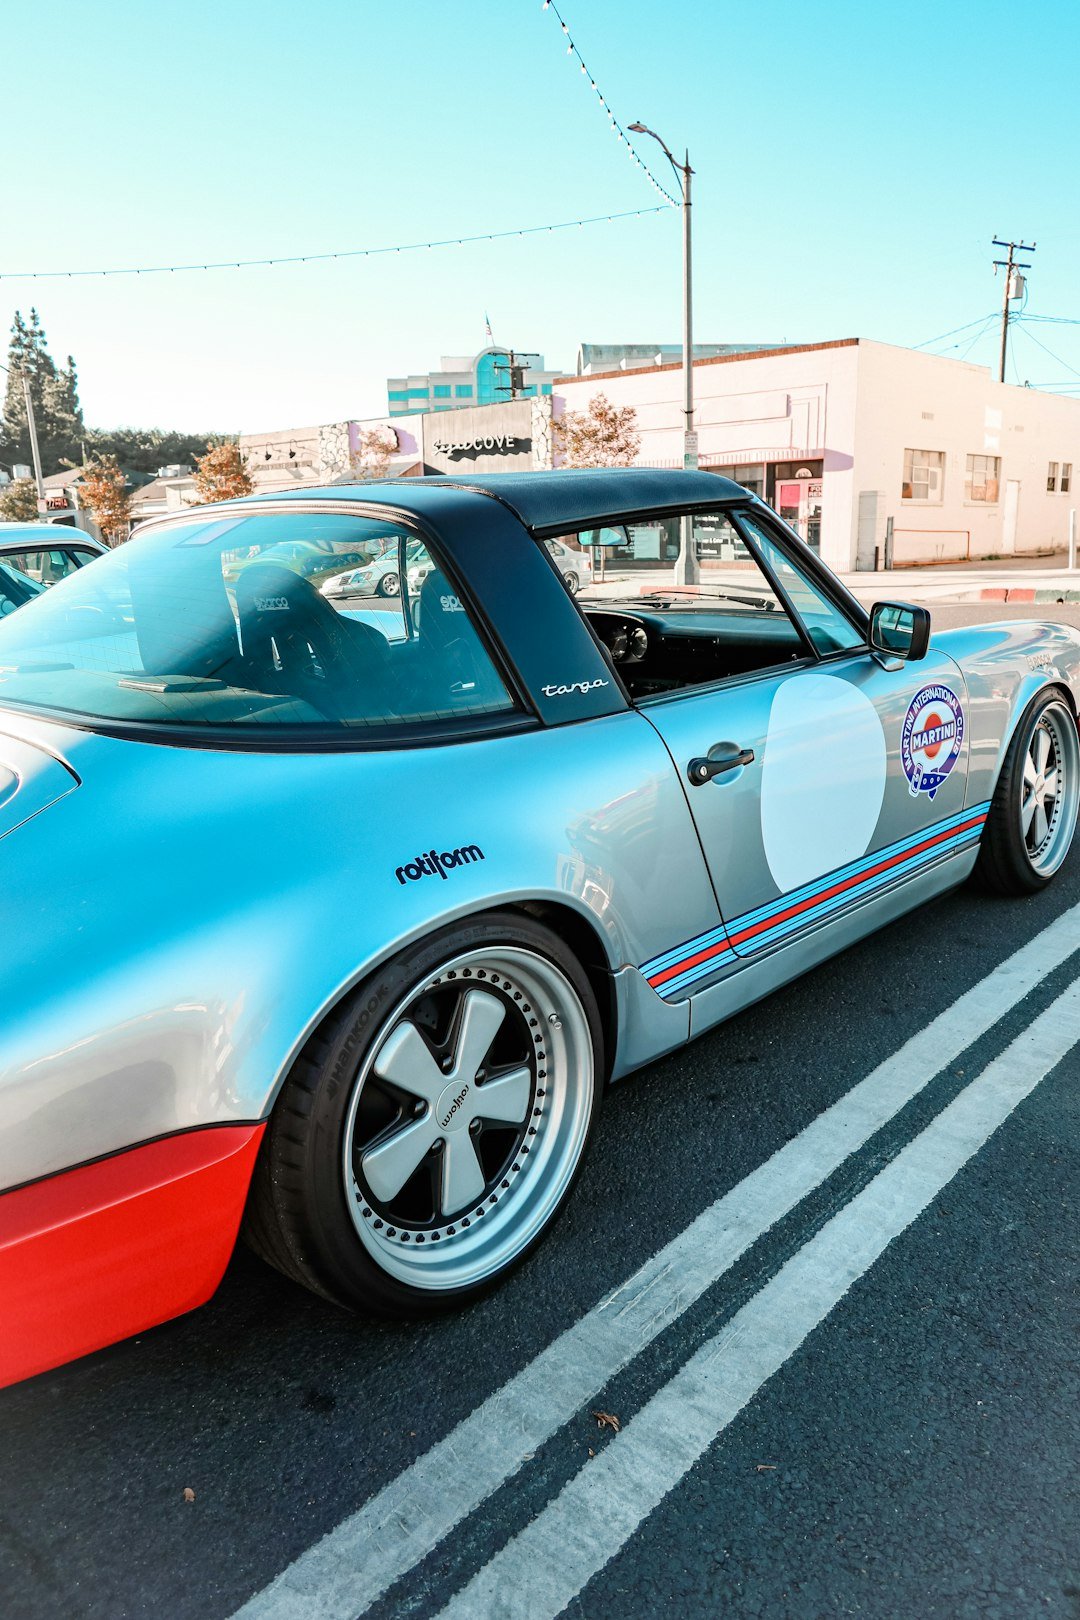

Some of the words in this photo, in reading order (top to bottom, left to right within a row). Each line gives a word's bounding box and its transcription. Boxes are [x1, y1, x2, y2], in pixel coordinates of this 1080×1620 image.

[473, 433, 515, 450] COVE
[541, 678, 609, 696] targa
[903, 711, 915, 771] MARTINI
[913, 687, 959, 715] INTERNATIONAL
[953, 716, 963, 756] CLUB
[912, 722, 955, 750] MARTINI
[395, 844, 486, 885] rotiform
[441, 1084, 470, 1127] rotiform
